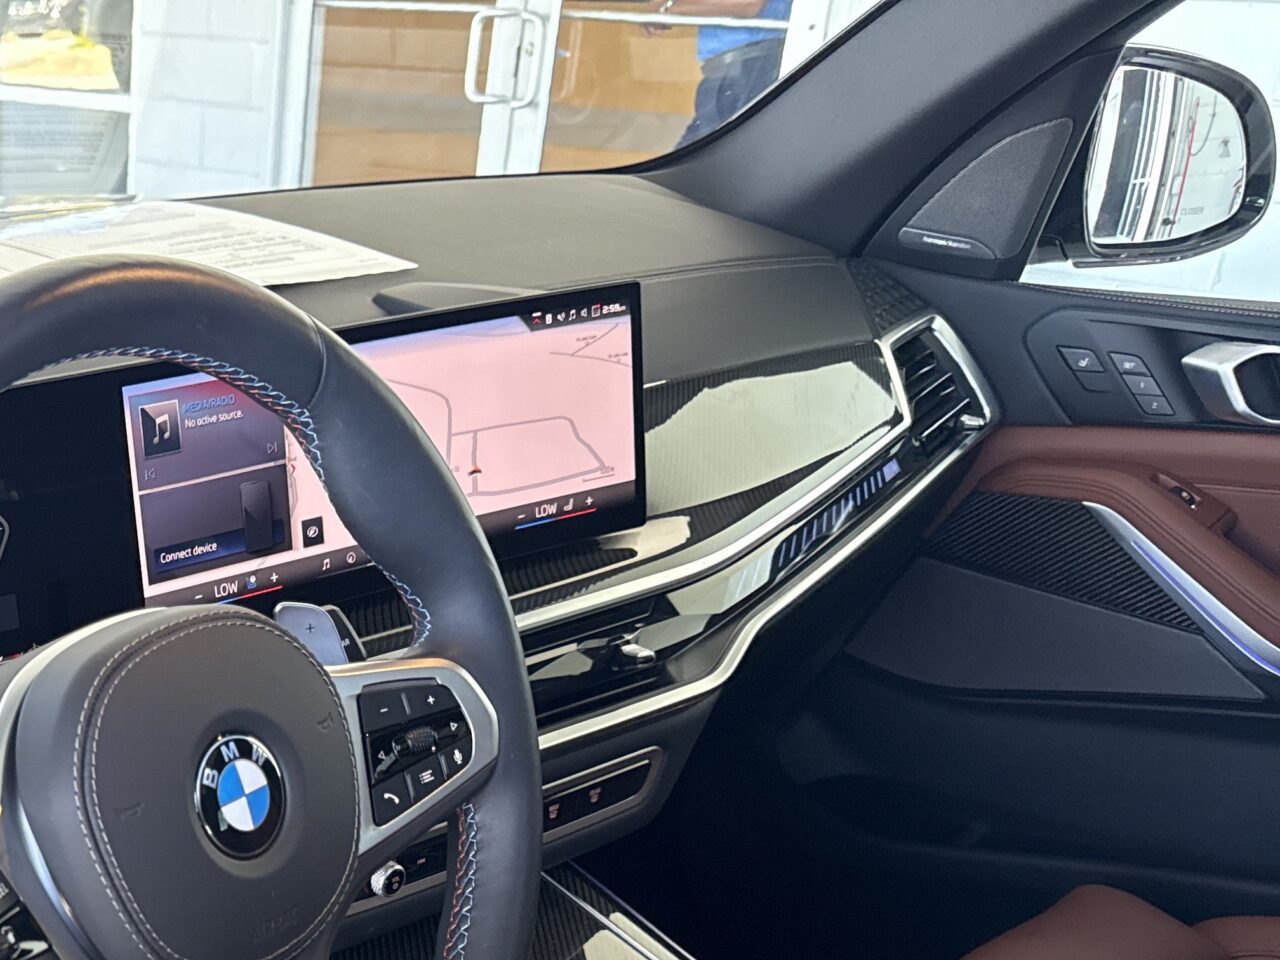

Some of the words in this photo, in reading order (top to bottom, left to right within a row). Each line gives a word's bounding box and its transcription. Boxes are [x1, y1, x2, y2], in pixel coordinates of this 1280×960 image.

[1180, 206, 1205, 216] CLOSER
[184, 418, 196, 428] No
[196, 414, 218, 426] active
[219, 410, 244, 422] source.
[536, 502, 558, 518] LOW
[160, 548, 192, 564] Connect
[193, 542, 218, 557] device
[214, 580, 238, 598] LOW
[202, 741, 268, 790] BMW
